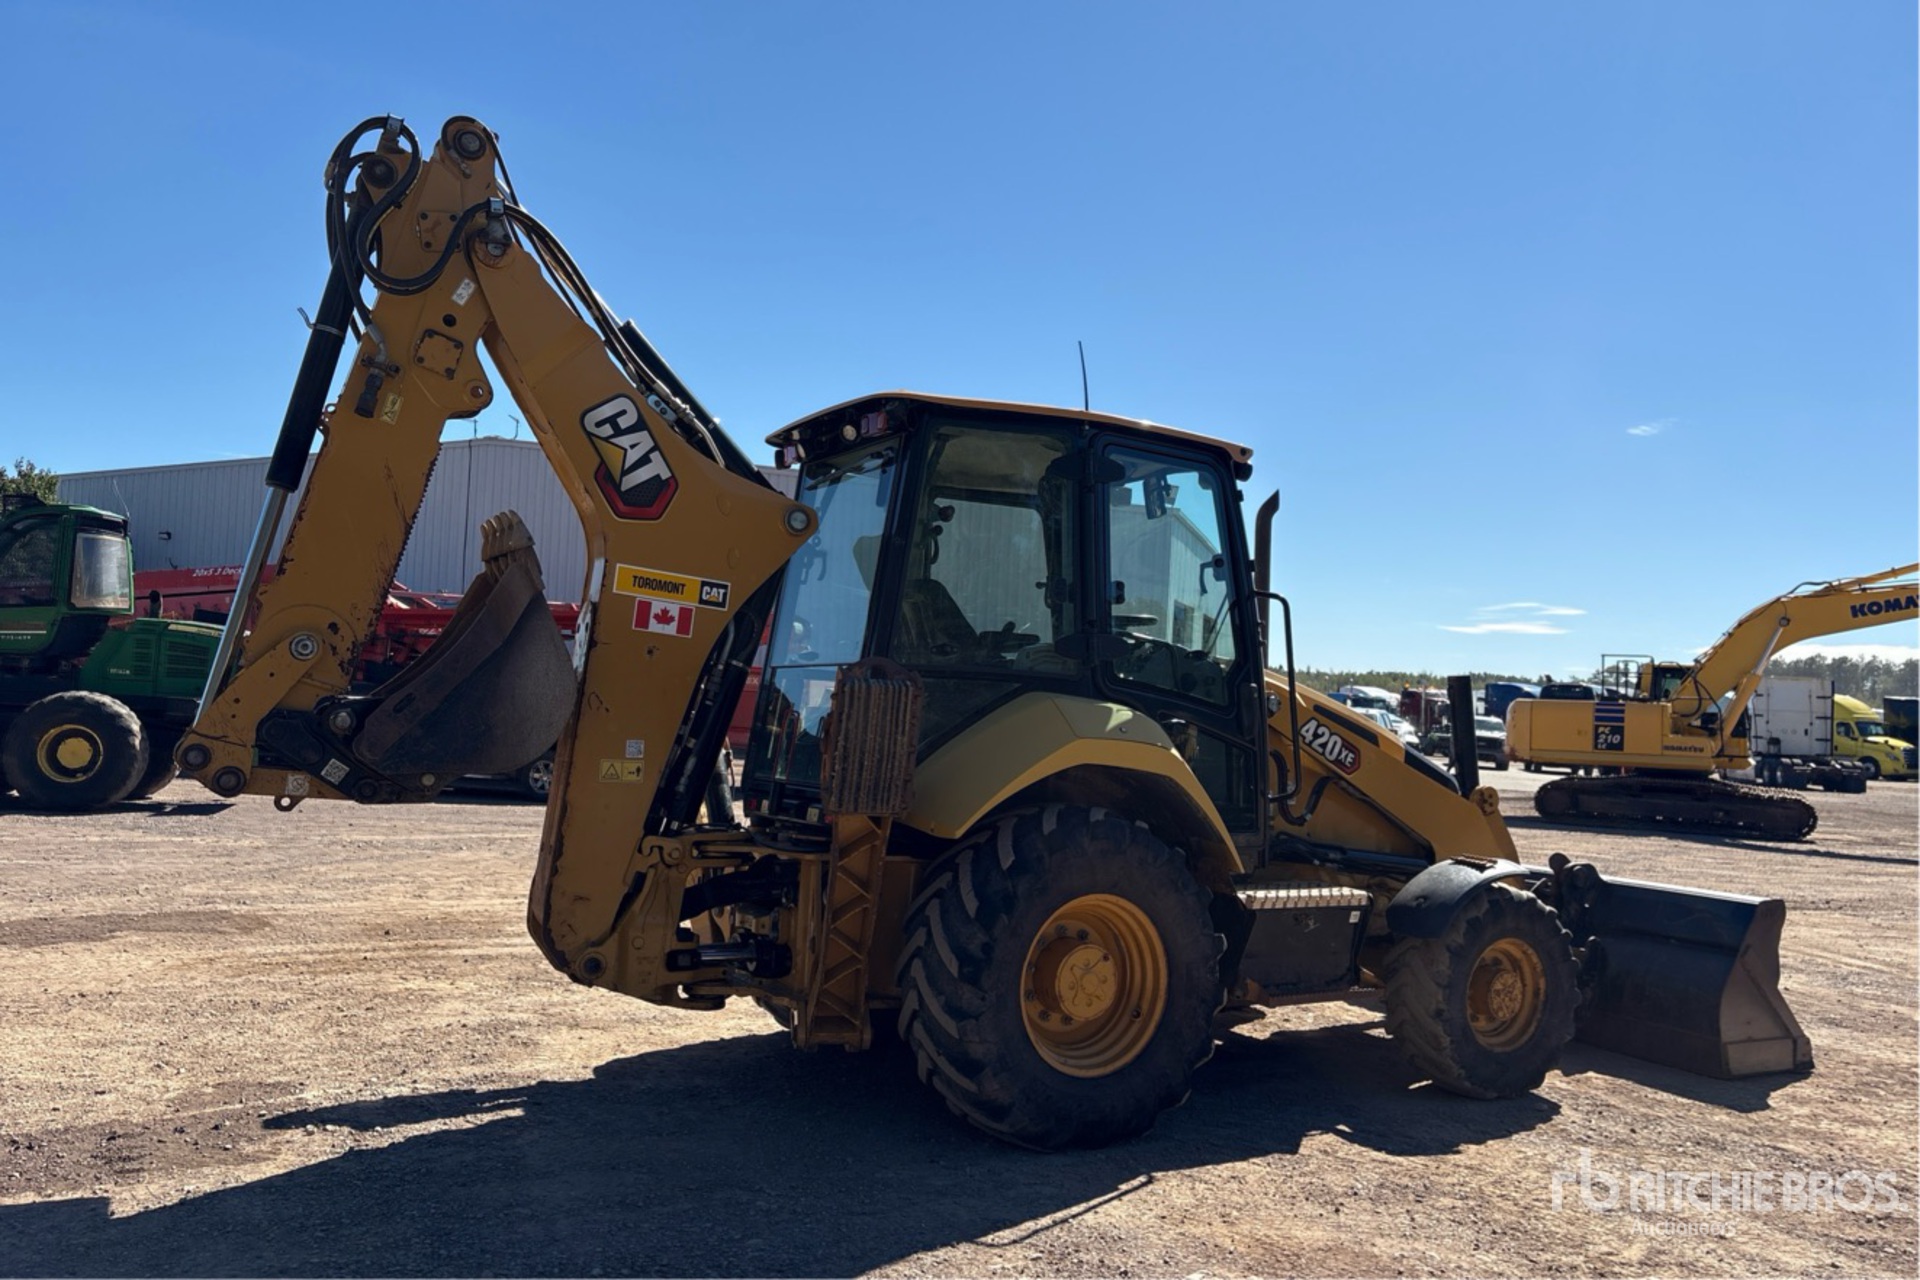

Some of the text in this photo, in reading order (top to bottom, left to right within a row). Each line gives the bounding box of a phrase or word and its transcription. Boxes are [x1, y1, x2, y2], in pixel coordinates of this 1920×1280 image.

[583, 396, 673, 492] CAT
[632, 575, 726, 602] TOROMONT CAT
[1850, 595, 1919, 618] KOMA
[1597, 733, 1621, 744] 210
